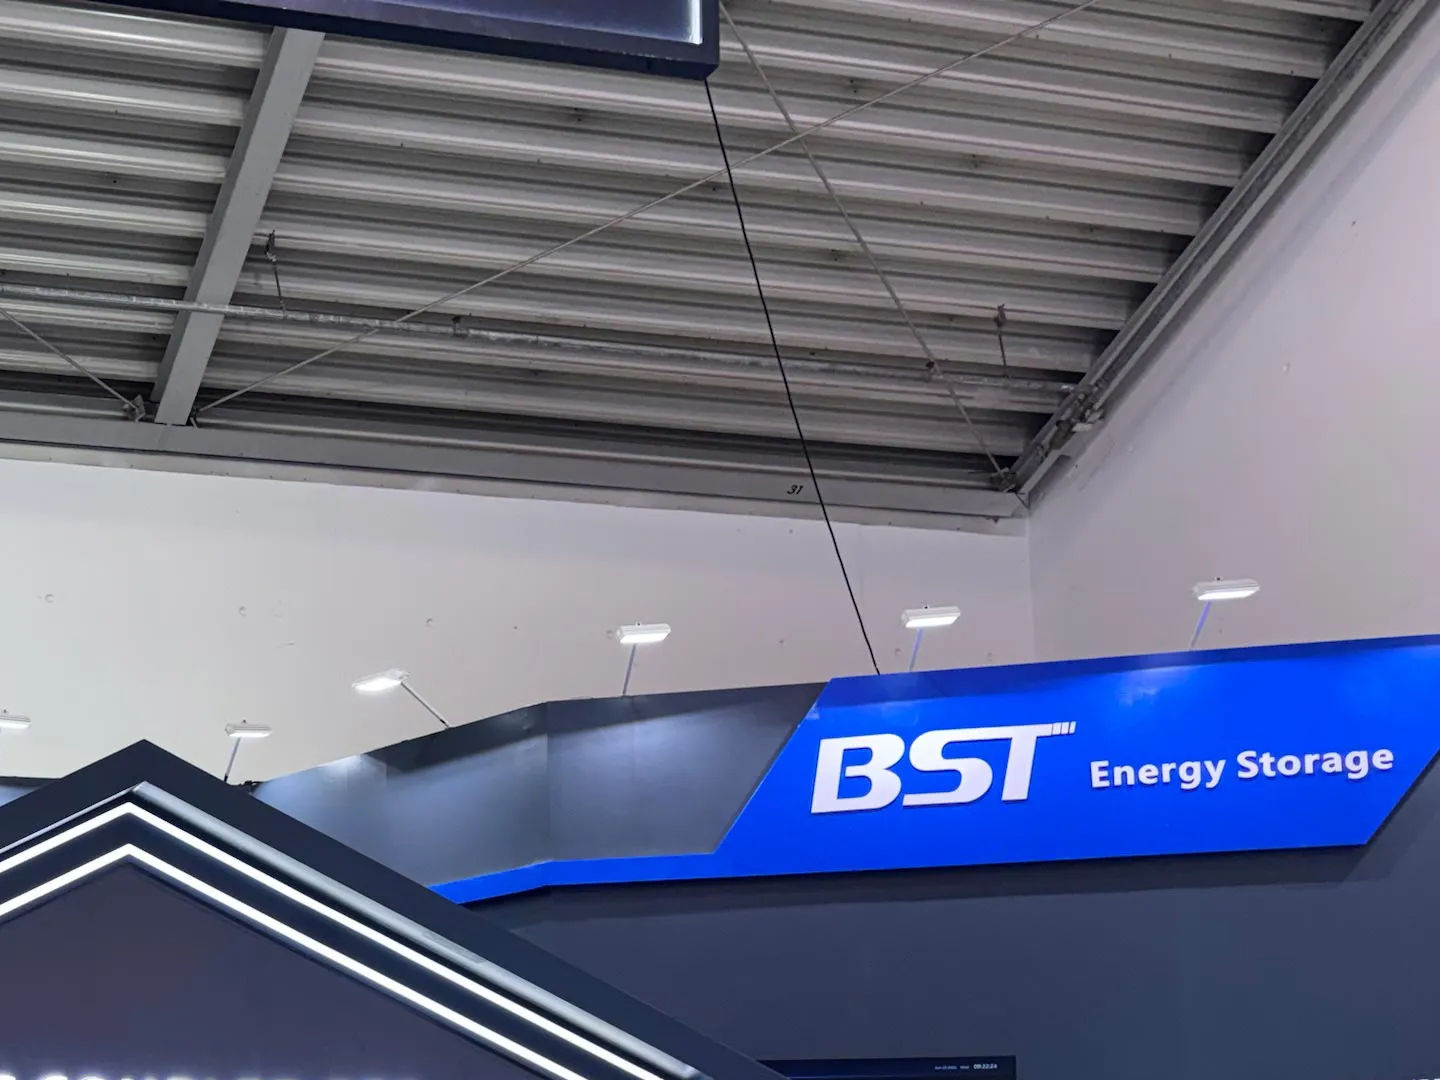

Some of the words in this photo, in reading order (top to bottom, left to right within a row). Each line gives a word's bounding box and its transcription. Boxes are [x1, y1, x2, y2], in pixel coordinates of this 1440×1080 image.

[786, 484, 804, 495] 31
[810, 721, 1076, 814] BST
[1090, 758, 1226, 789] Energy
[1236, 748, 1394, 780] Storage
